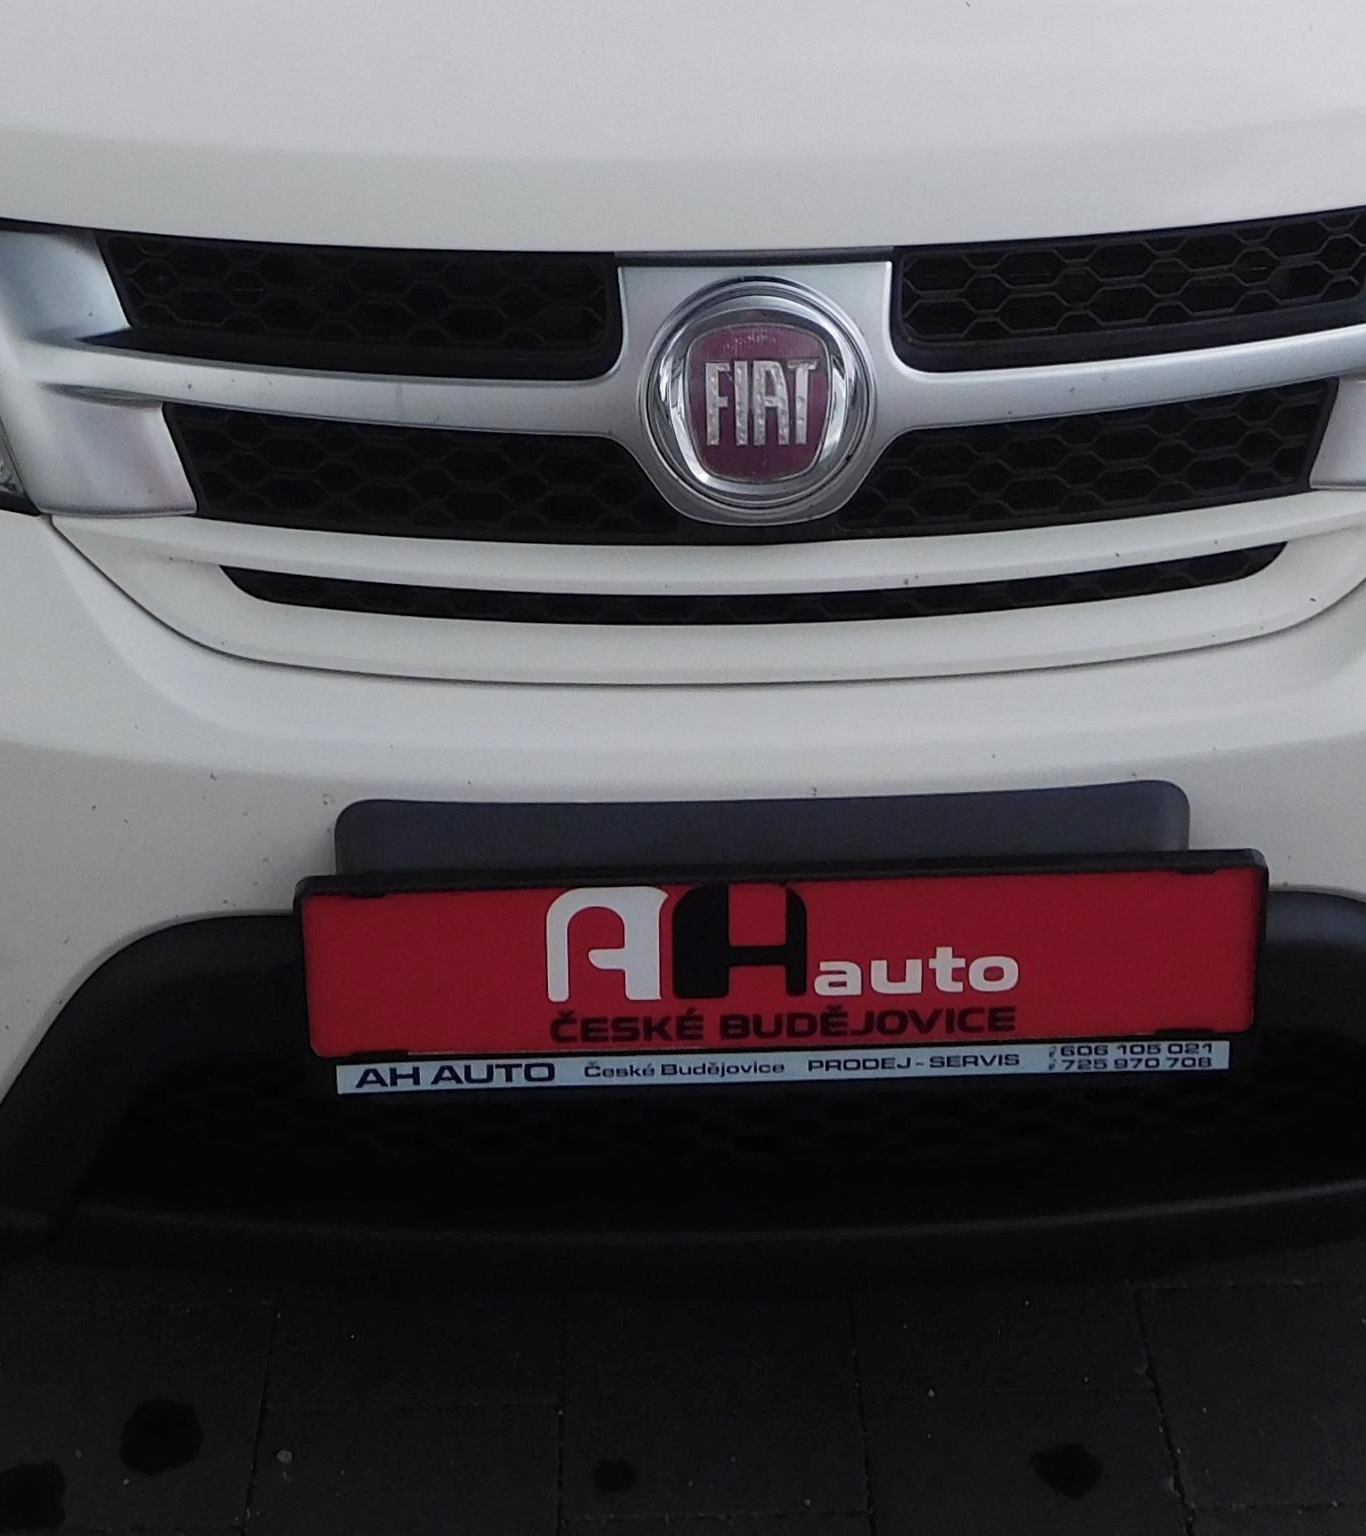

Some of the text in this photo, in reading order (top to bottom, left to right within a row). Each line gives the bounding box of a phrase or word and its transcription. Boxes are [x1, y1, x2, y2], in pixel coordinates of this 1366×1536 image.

[705, 360, 818, 446] FIAT
[546, 883, 1019, 1002] AH auto
[550, 1005, 1016, 1043] ČESKÉ BUDĚJOVICE
[1060, 1042, 1213, 1057] 606 105 021
[1061, 1058, 1108, 1071] 725
[1114, 1057, 1161, 1070] 970
[355, 1066, 420, 1089] AH
[431, 1062, 556, 1085] AUTO
[584, 1061, 655, 1078] České
[660, 1060, 786, 1078] Budějovice
